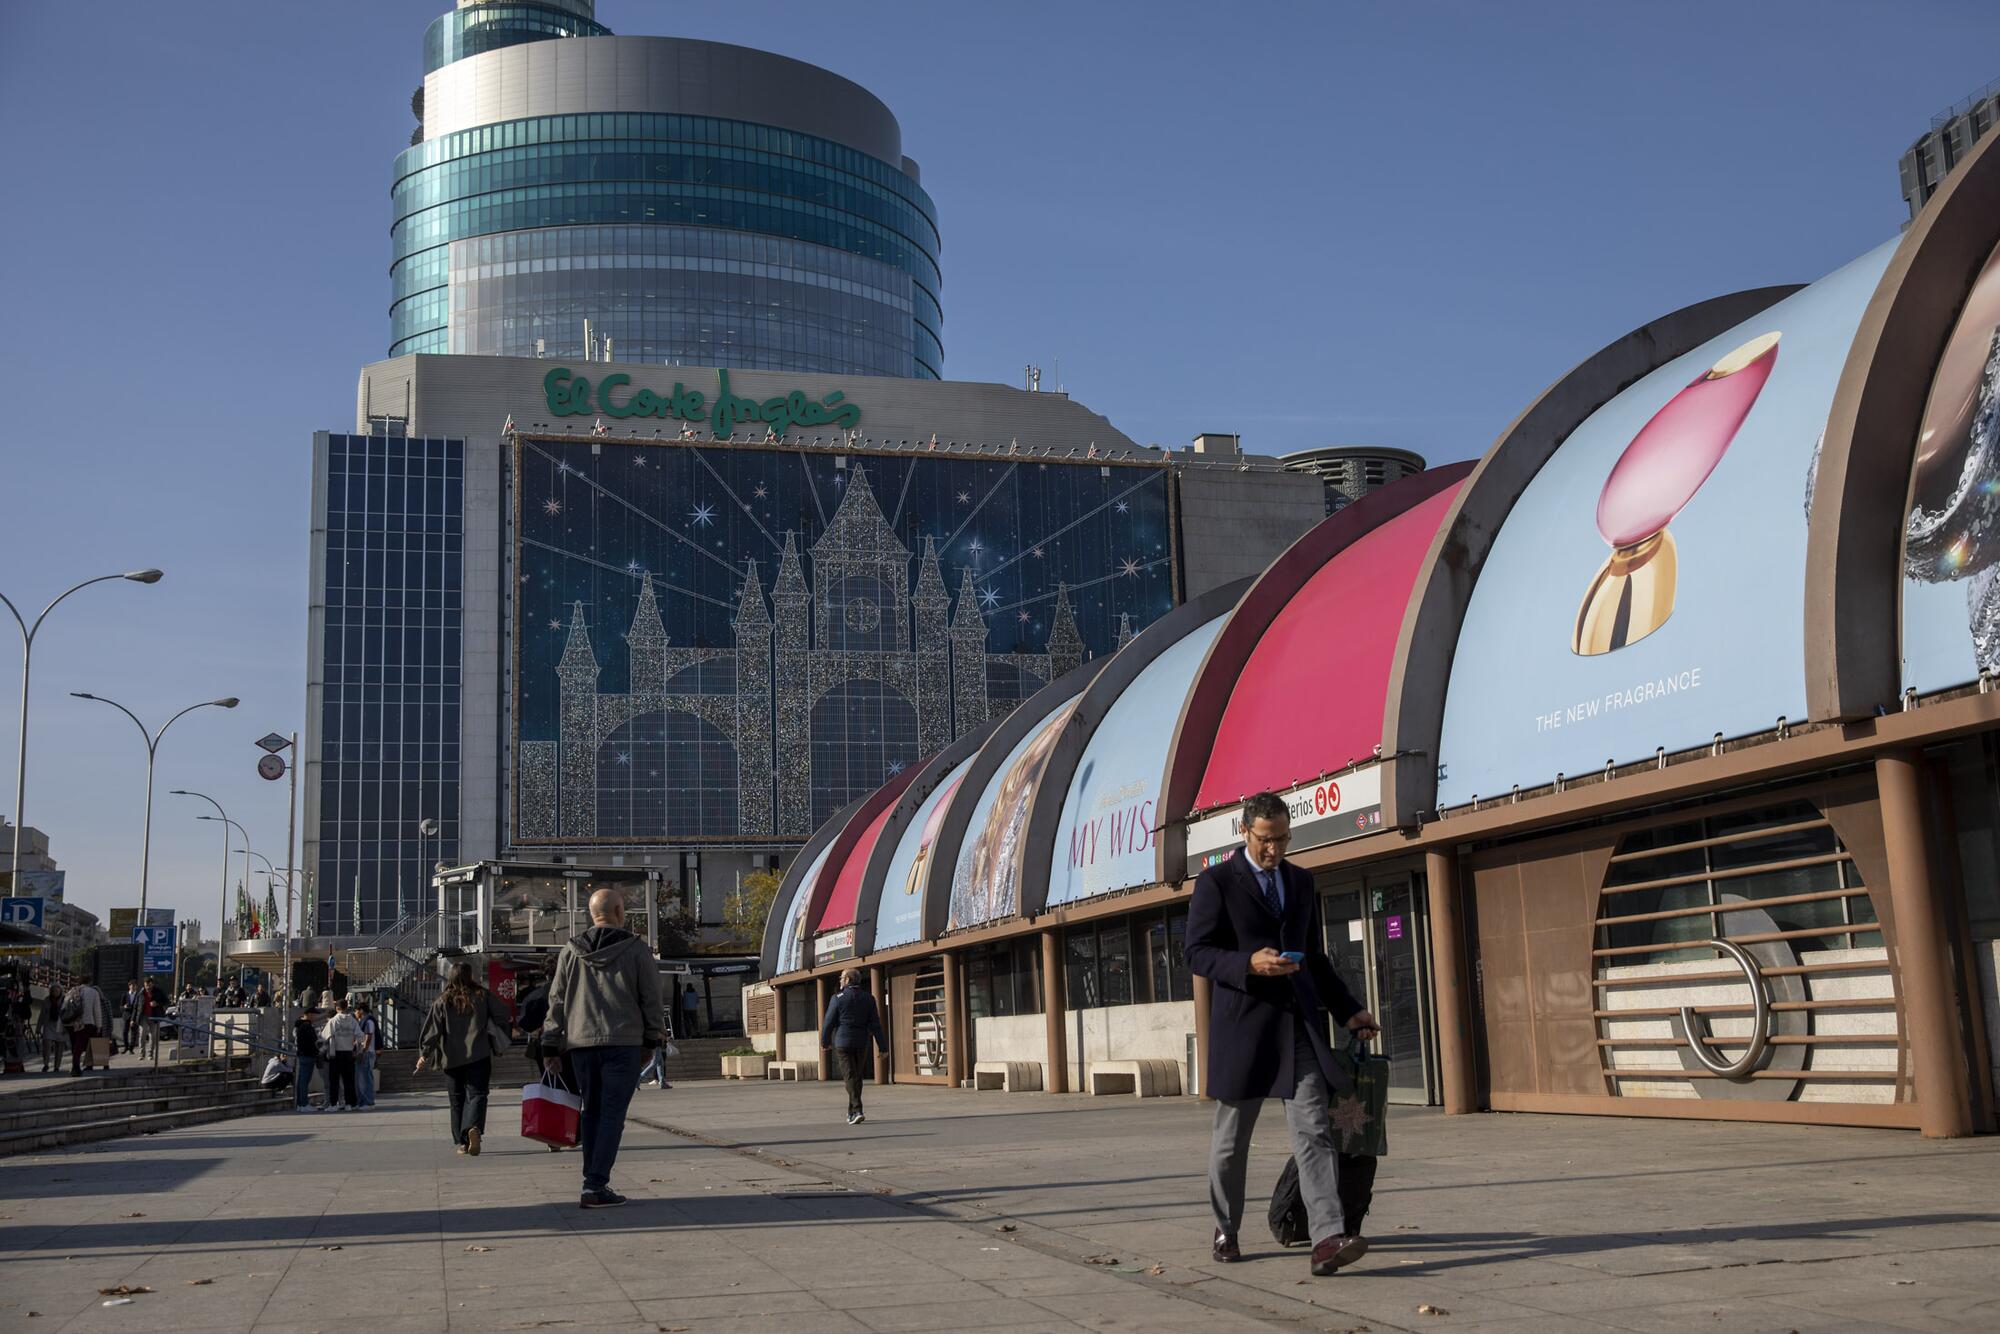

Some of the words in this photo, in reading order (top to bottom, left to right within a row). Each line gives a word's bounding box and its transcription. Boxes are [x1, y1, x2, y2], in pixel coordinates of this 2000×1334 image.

[542, 366, 595, 417] El
[598, 372, 706, 422] Corte
[711, 368, 862, 440] Inglés
[1535, 711, 1562, 734] THE
[1566, 698, 1601, 724] NEW
[1605, 667, 1702, 713] FRAGRANCE
[1067, 816, 1104, 871] MY
[155, 930, 167, 945] P
